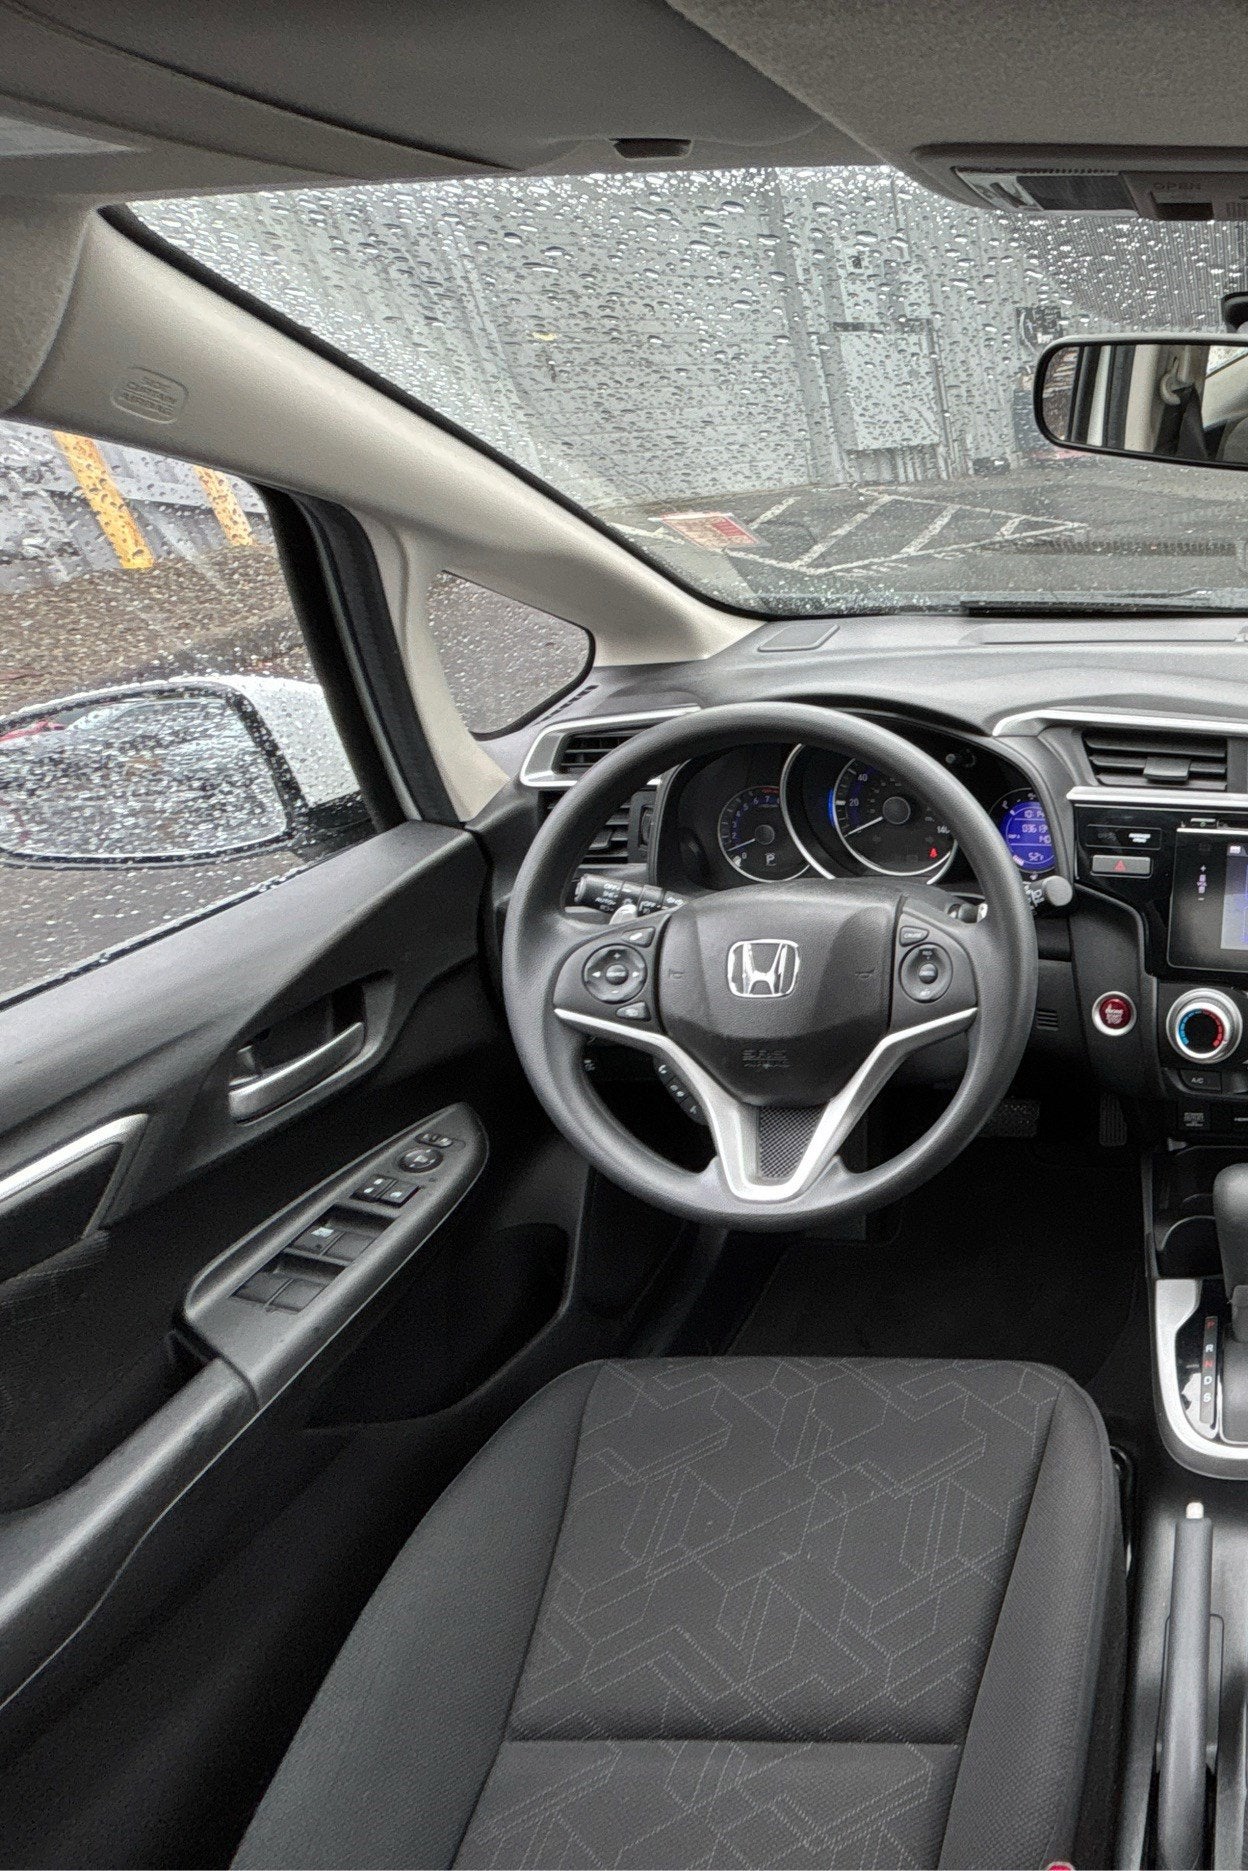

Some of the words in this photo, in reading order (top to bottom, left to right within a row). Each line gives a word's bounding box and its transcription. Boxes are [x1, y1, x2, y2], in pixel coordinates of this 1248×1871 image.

[1153, 182, 1201, 190] OPEN
[858, 773, 868, 782] 40
[849, 798, 859, 807] 20
[1206, 1321, 1216, 1329] P
[1205, 1344, 1214, 1353] R
[1204, 1360, 1213, 1368] N
[1203, 1375, 1213, 1385] D
[1203, 1392, 1212, 1403] S
